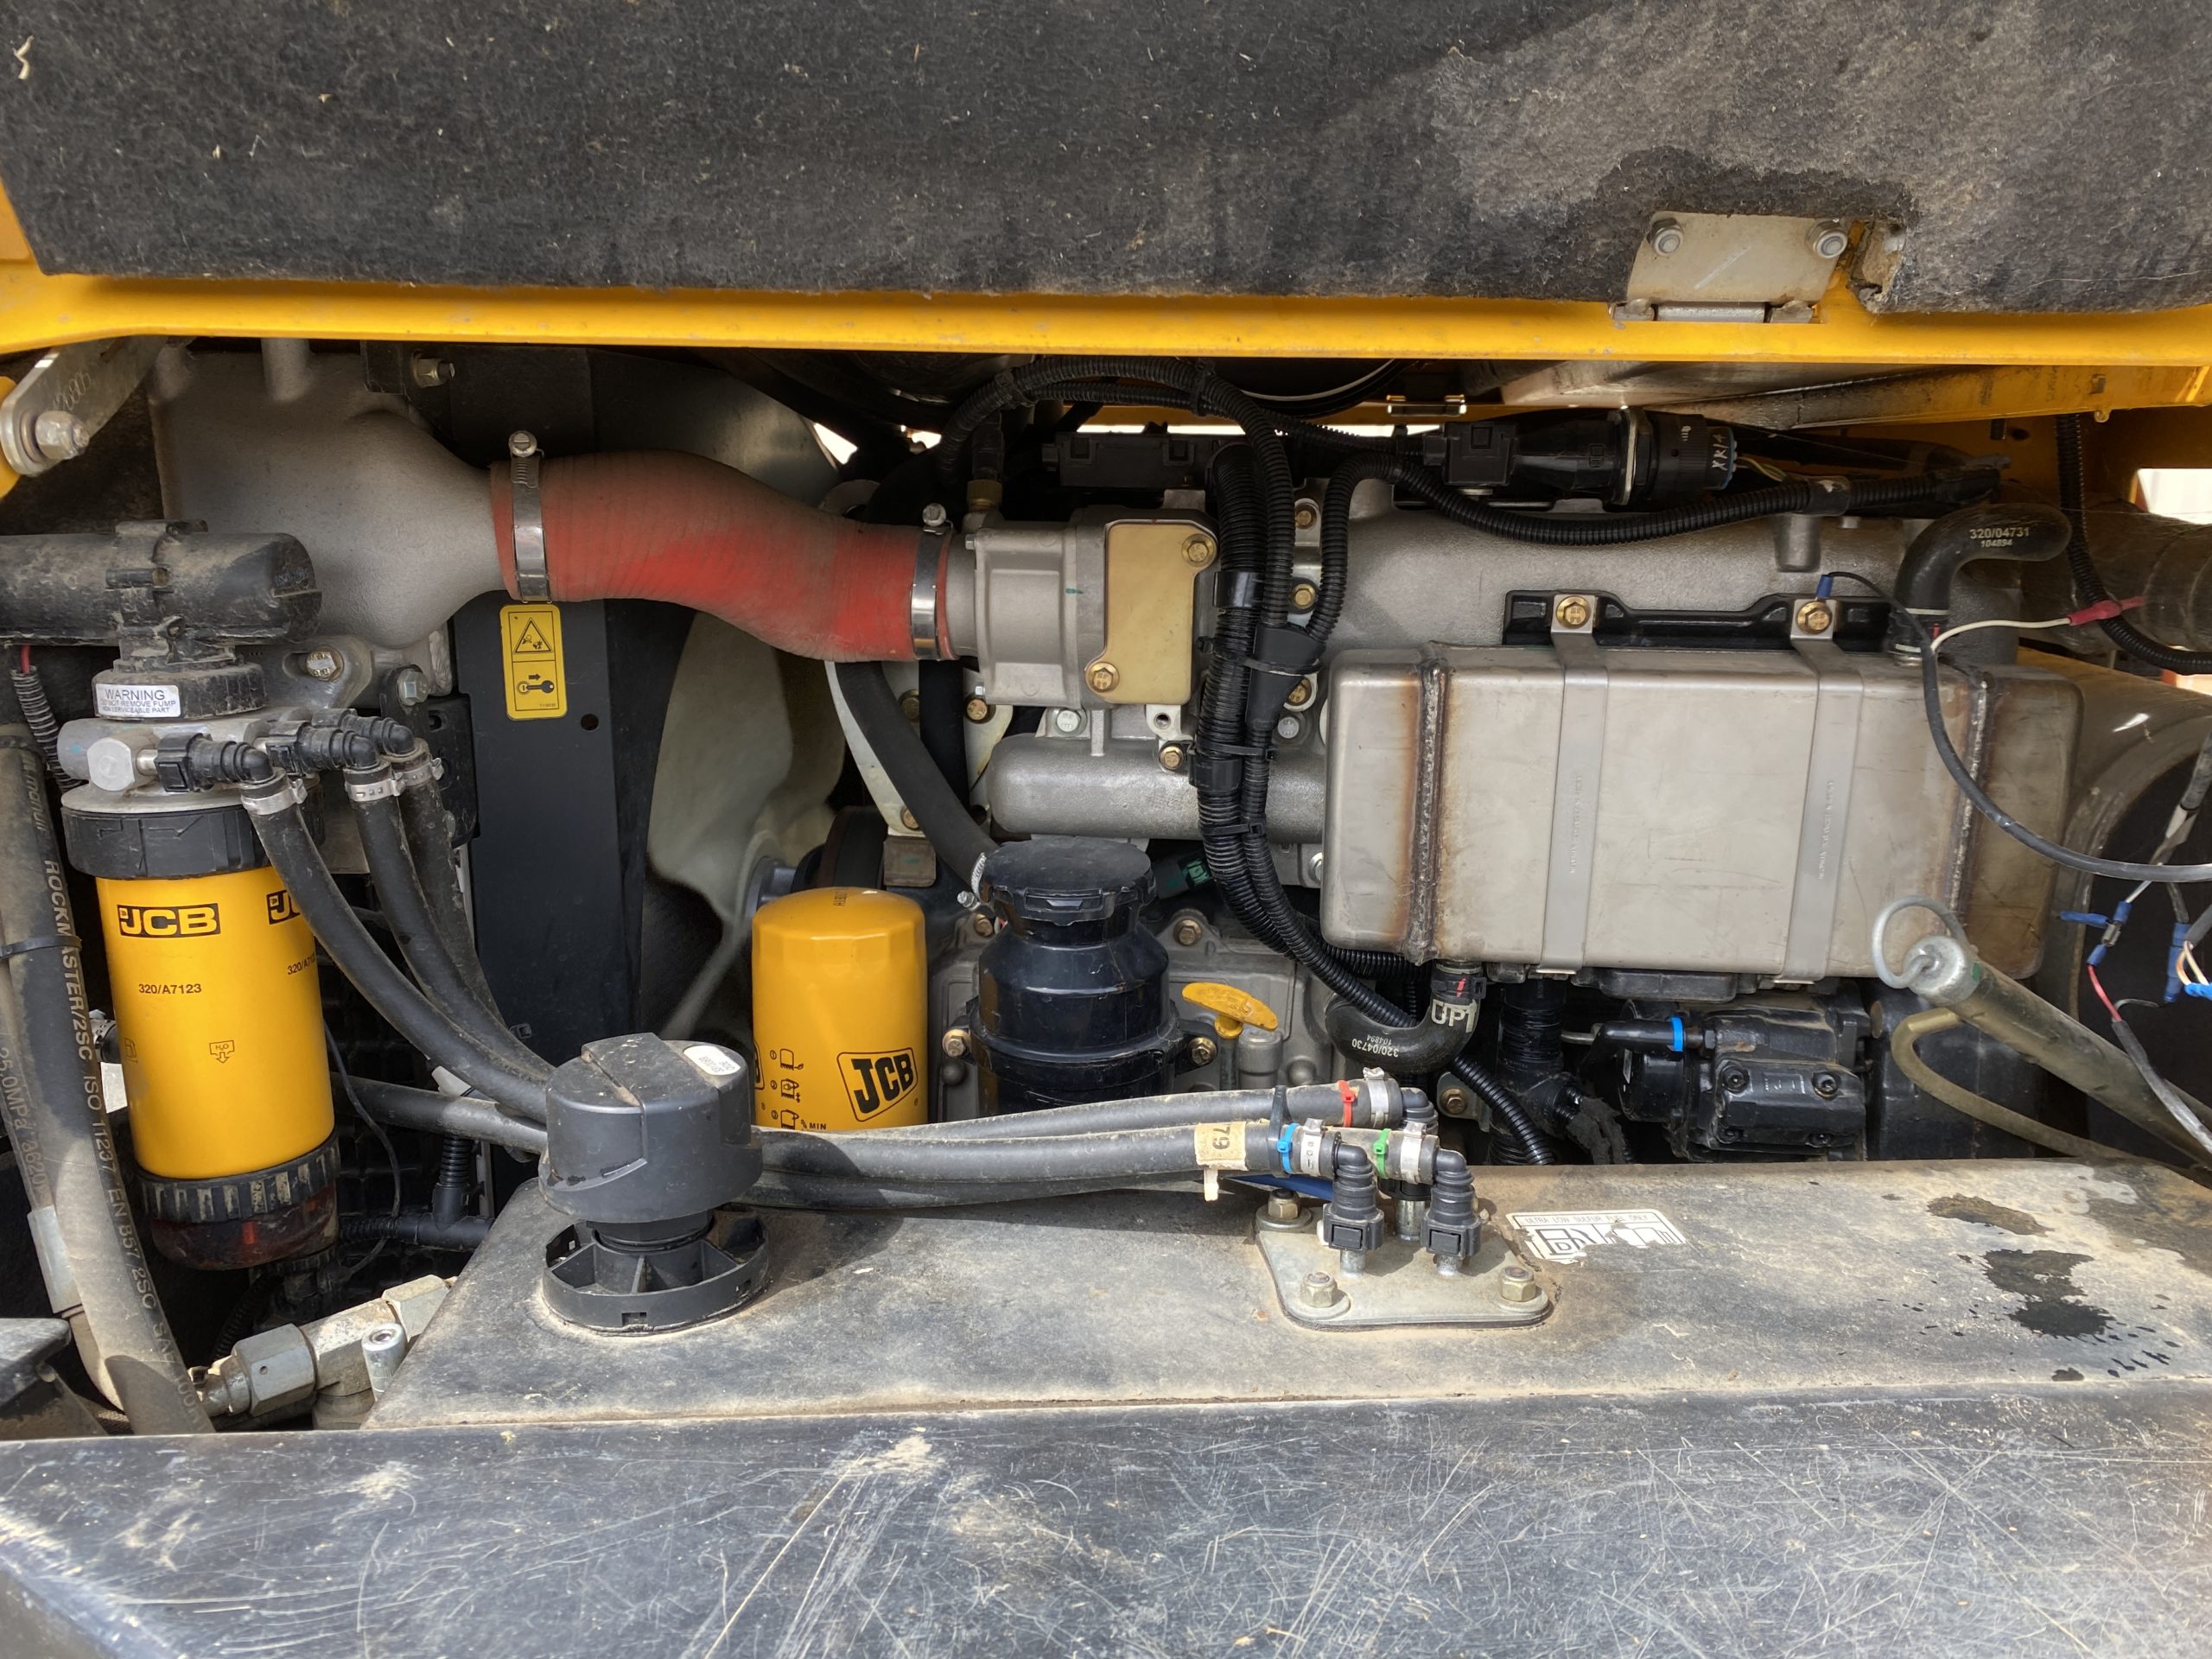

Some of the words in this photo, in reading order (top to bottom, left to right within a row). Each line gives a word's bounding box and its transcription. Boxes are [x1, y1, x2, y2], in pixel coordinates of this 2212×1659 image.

[1969, 527, 2031, 539] 320/04731
[1980, 538, 2013, 548] 104894
[105, 689, 165, 701] WARNING
[119, 905, 219, 937] JCB
[138, 983, 202, 995] 320/A7123
[1351, 1038, 1400, 1058] 320/04730
[850, 1052, 914, 1114] JCB
[83, 1075, 102, 1111] ISO
[107, 1188, 128, 1218] EN
